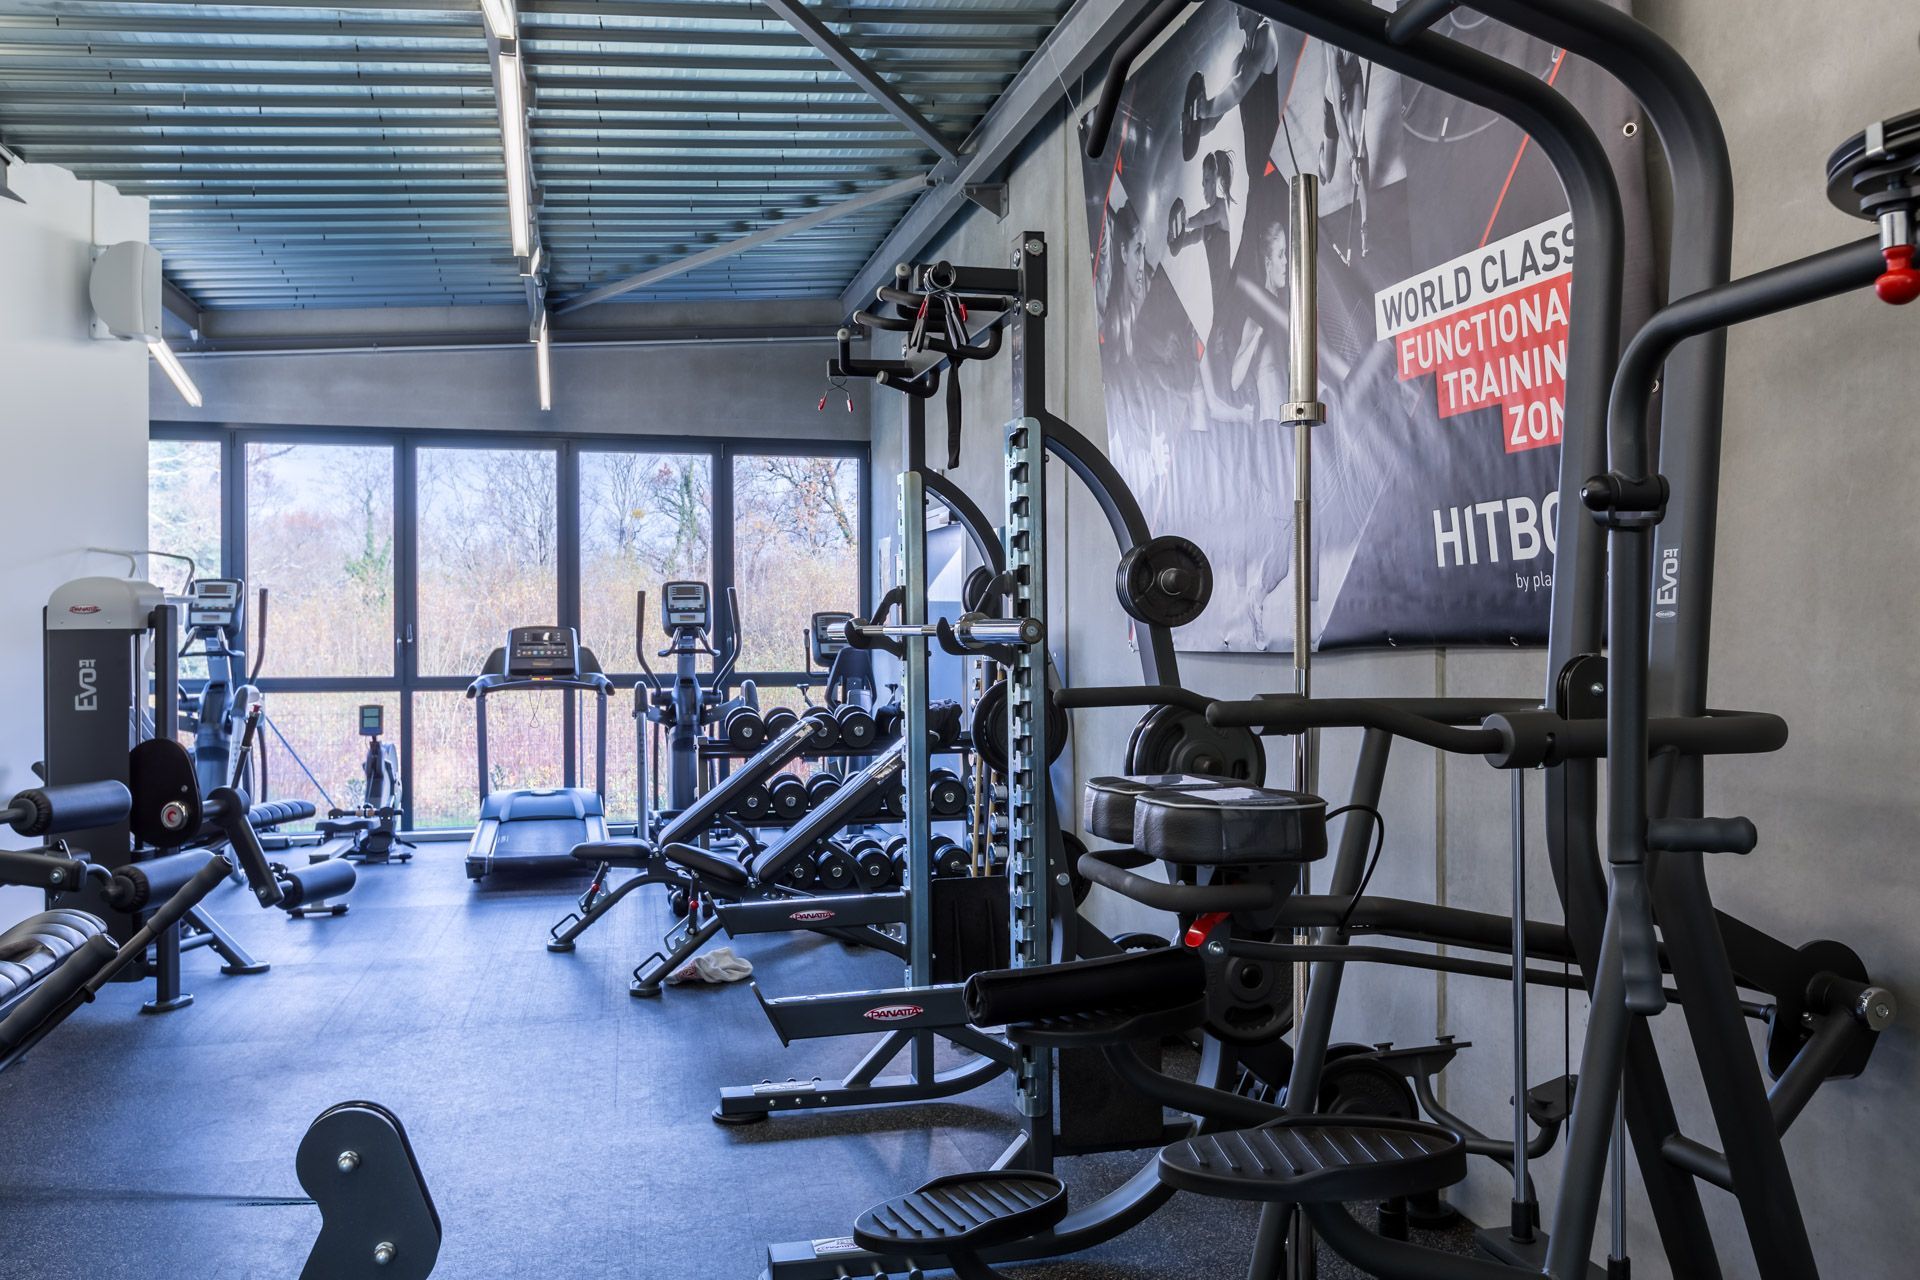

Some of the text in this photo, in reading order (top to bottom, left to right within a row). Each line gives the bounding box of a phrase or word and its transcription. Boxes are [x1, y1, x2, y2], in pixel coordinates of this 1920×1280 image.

[1382, 222, 1574, 331] WORLD CLASS
[1402, 282, 1572, 375] FUNCTIONA
[1516, 573, 1530, 592] by
[867, 1005, 922, 1020] PANATTA
